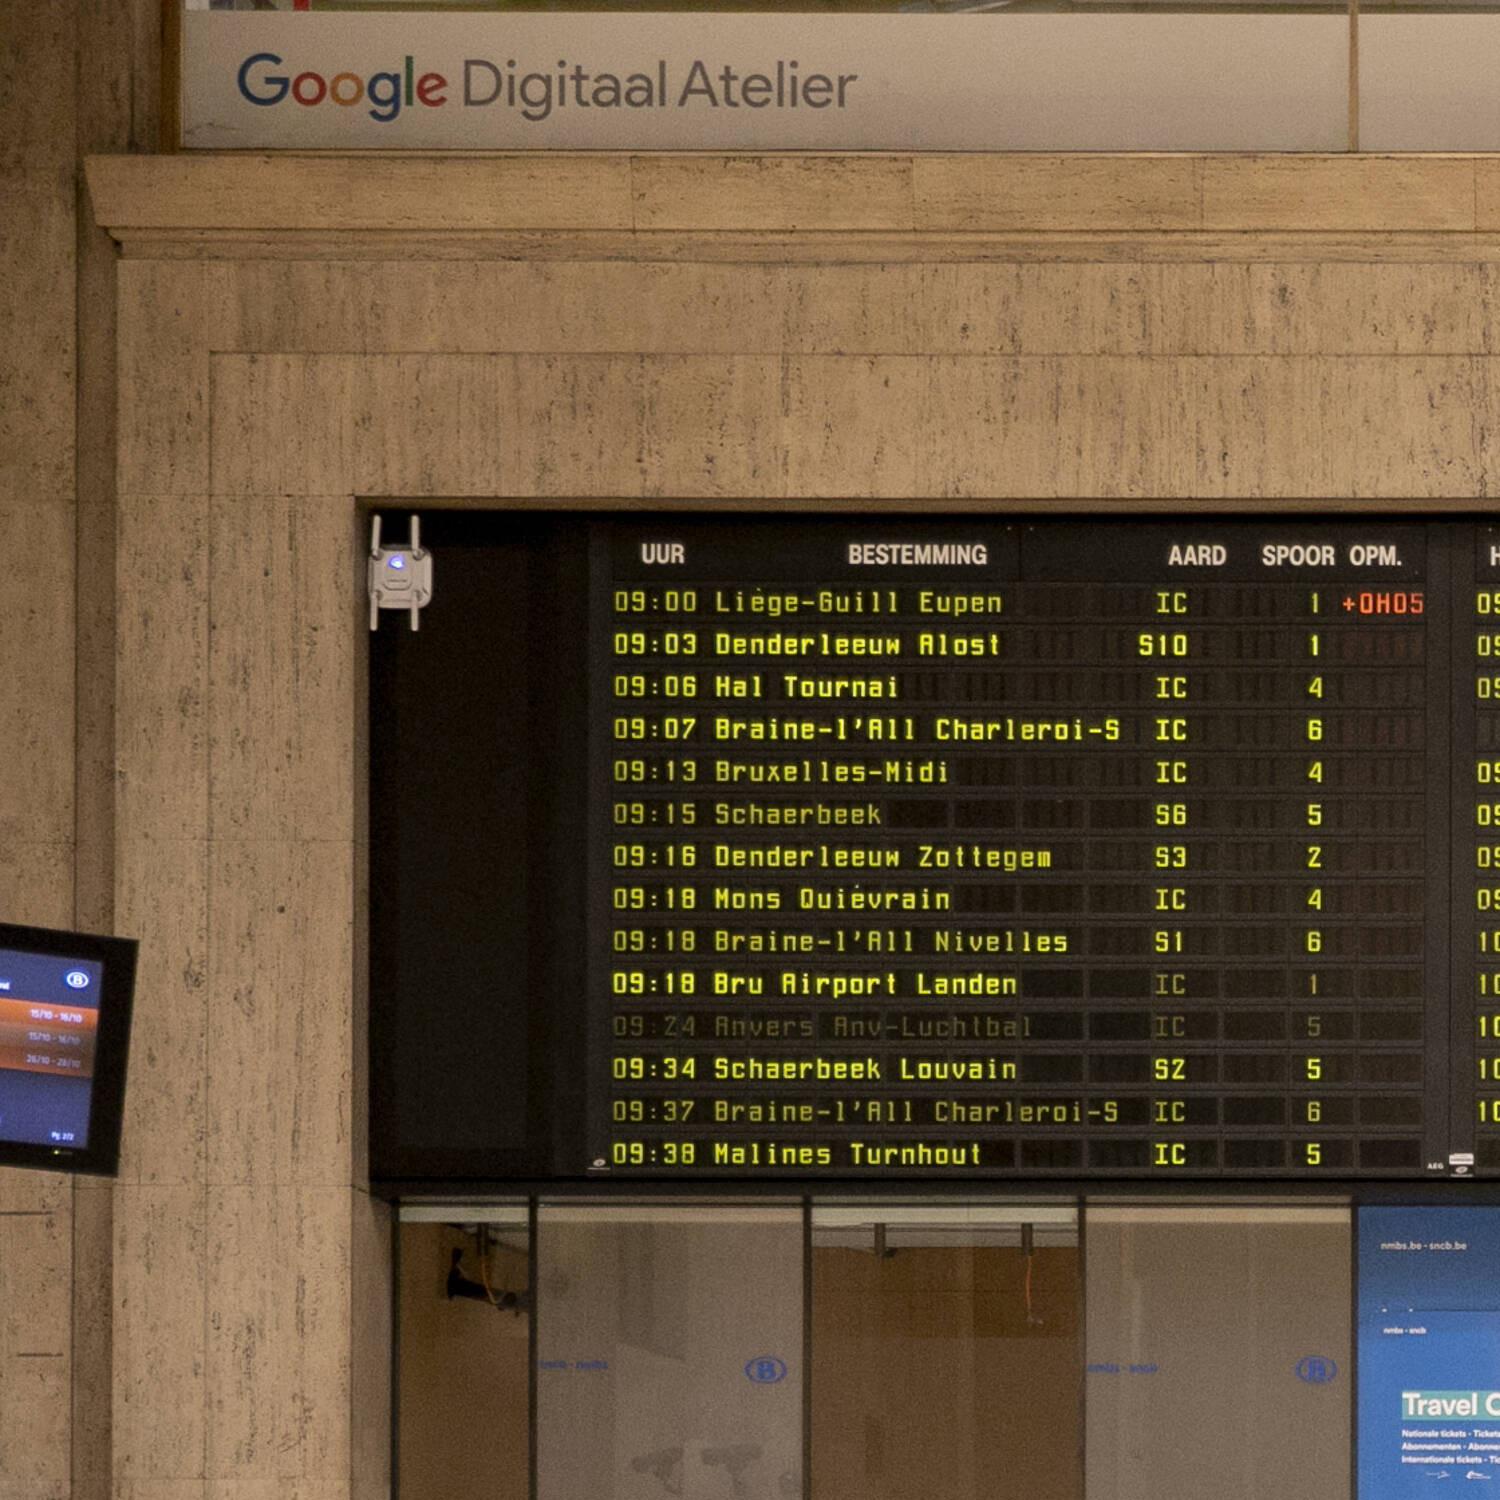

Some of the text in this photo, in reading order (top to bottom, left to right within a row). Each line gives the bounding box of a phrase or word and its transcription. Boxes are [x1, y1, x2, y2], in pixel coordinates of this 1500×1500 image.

[236, 52, 858, 123] Google Digitaal Atelier
[641, 543, 1402, 567] UUR BESTEMMING AARD SPOOR OPM.
[613, 589, 697, 613] 09:00
[918, 590, 1002, 617] Eupen
[1155, 590, 1188, 614] IC
[1309, 591, 1320, 614] 1
[613, 631, 1320, 657] 09:03 Denderleeuw Alost S10 1
[613, 716, 696, 740] 09:07
[934, 717, 1120, 741] Charleroi-S
[1155, 717, 1186, 742] IC
[1306, 717, 1322, 741] 6
[612, 1056, 1322, 1081] 09:34 Schaerbeek Louvain S2 5
[1380, 1240, 1467, 1250] nmbs.be sncb.be
[1402, 1391, 1478, 1416] Travel
[1402, 1429, 1439, 1438] Nationale
[1440, 1429, 1467, 1438] tickets
[1473, 1430, 1500, 1438] Tickets
